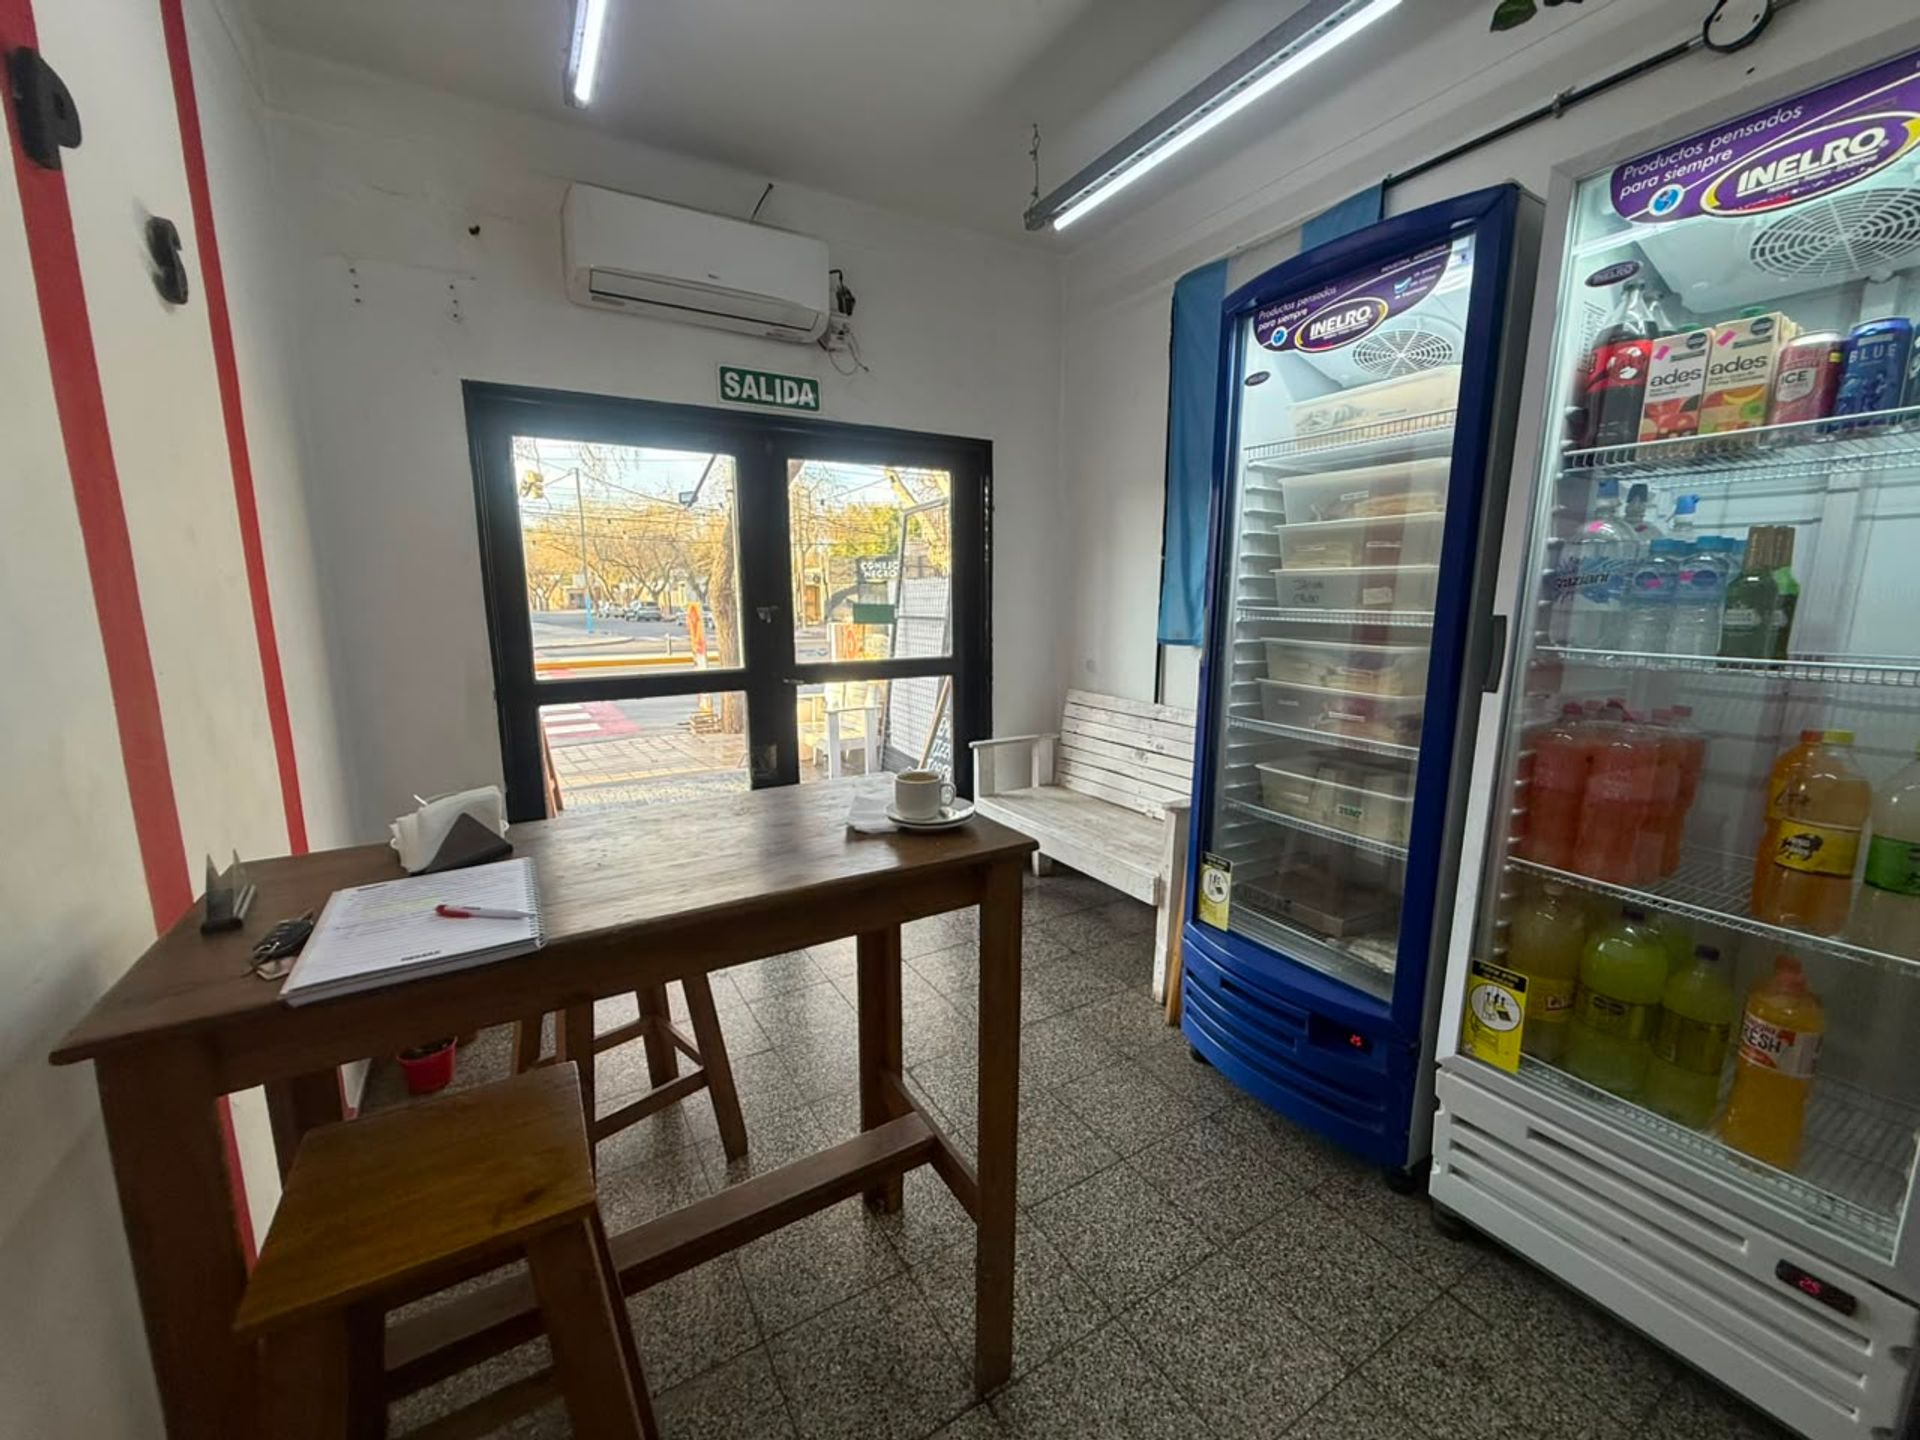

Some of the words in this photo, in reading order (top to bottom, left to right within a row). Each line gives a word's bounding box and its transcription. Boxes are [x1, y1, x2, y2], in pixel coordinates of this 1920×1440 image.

[1623, 142, 1704, 180] Productos
[1708, 106, 1803, 153] pensados
[1737, 127, 1886, 193] INELRO
[1620, 175, 1659, 200] para
[1663, 149, 1733, 182] siempre
[1258, 301, 1296, 320] Productos
[1310, 306, 1371, 337] INELRO
[1258, 319, 1277, 333] para
[1710, 356, 1768, 375] ades
[1849, 343, 1897, 363] BLUE
[724, 371, 816, 407] SALIDA
[1650, 368, 1702, 387] ades
